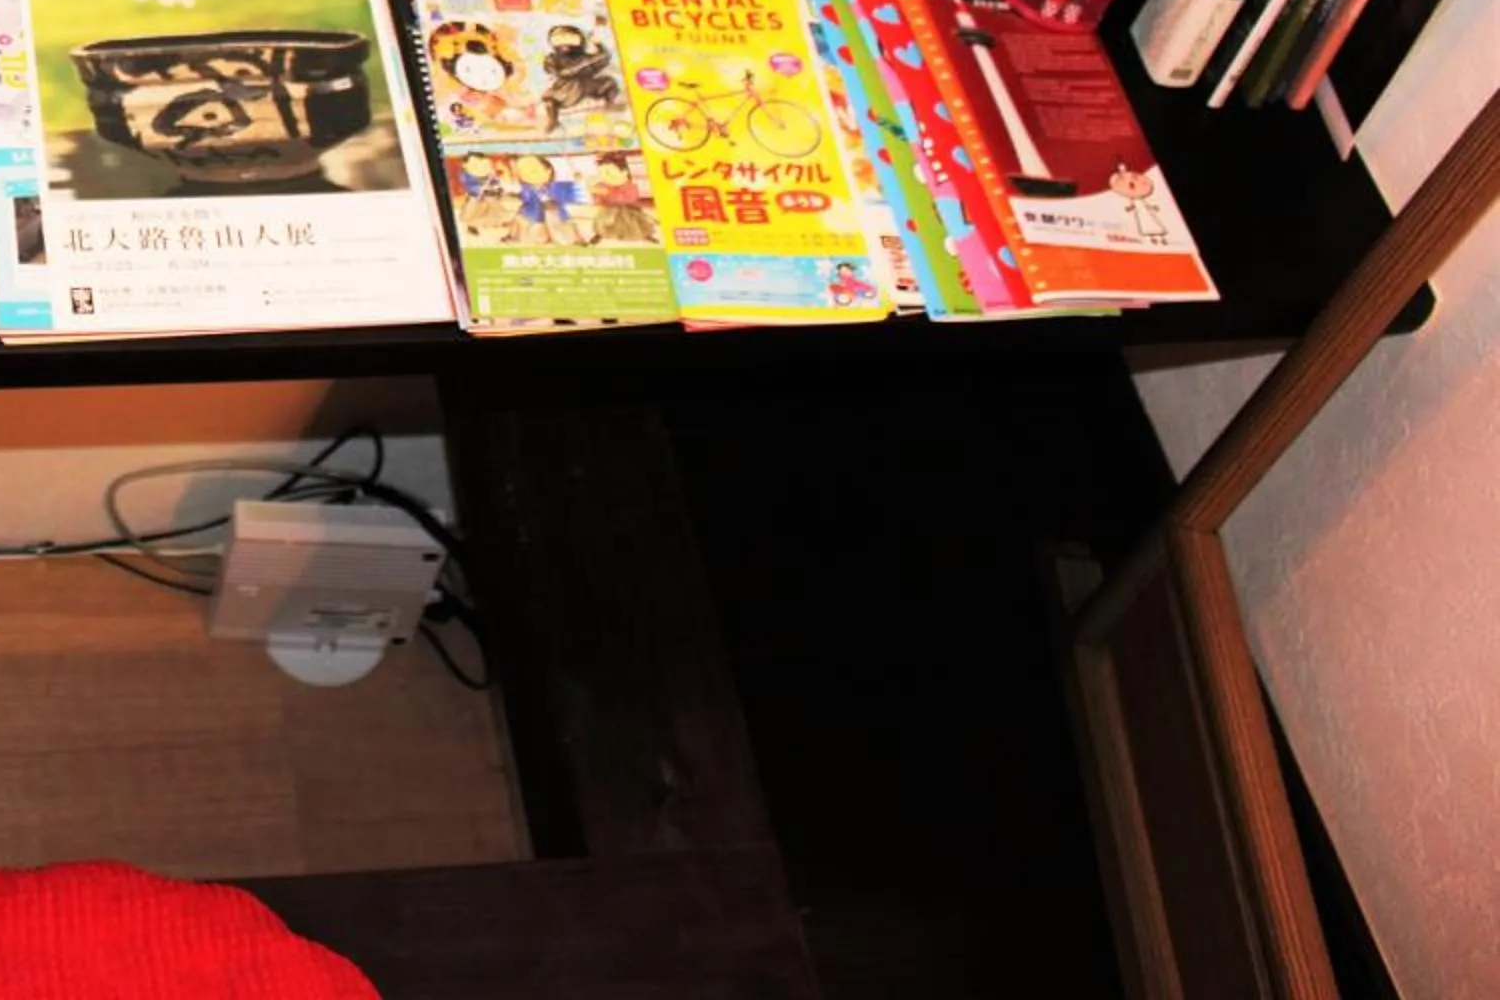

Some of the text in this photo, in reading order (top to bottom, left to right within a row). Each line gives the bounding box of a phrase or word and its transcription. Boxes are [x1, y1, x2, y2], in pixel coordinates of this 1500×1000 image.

[630, 8, 783, 31] BICYCLES
[661, 159, 831, 183] レンタサイクル
[680, 185, 771, 224] 風音
[63, 222, 316, 253] 北大路魯山人展
